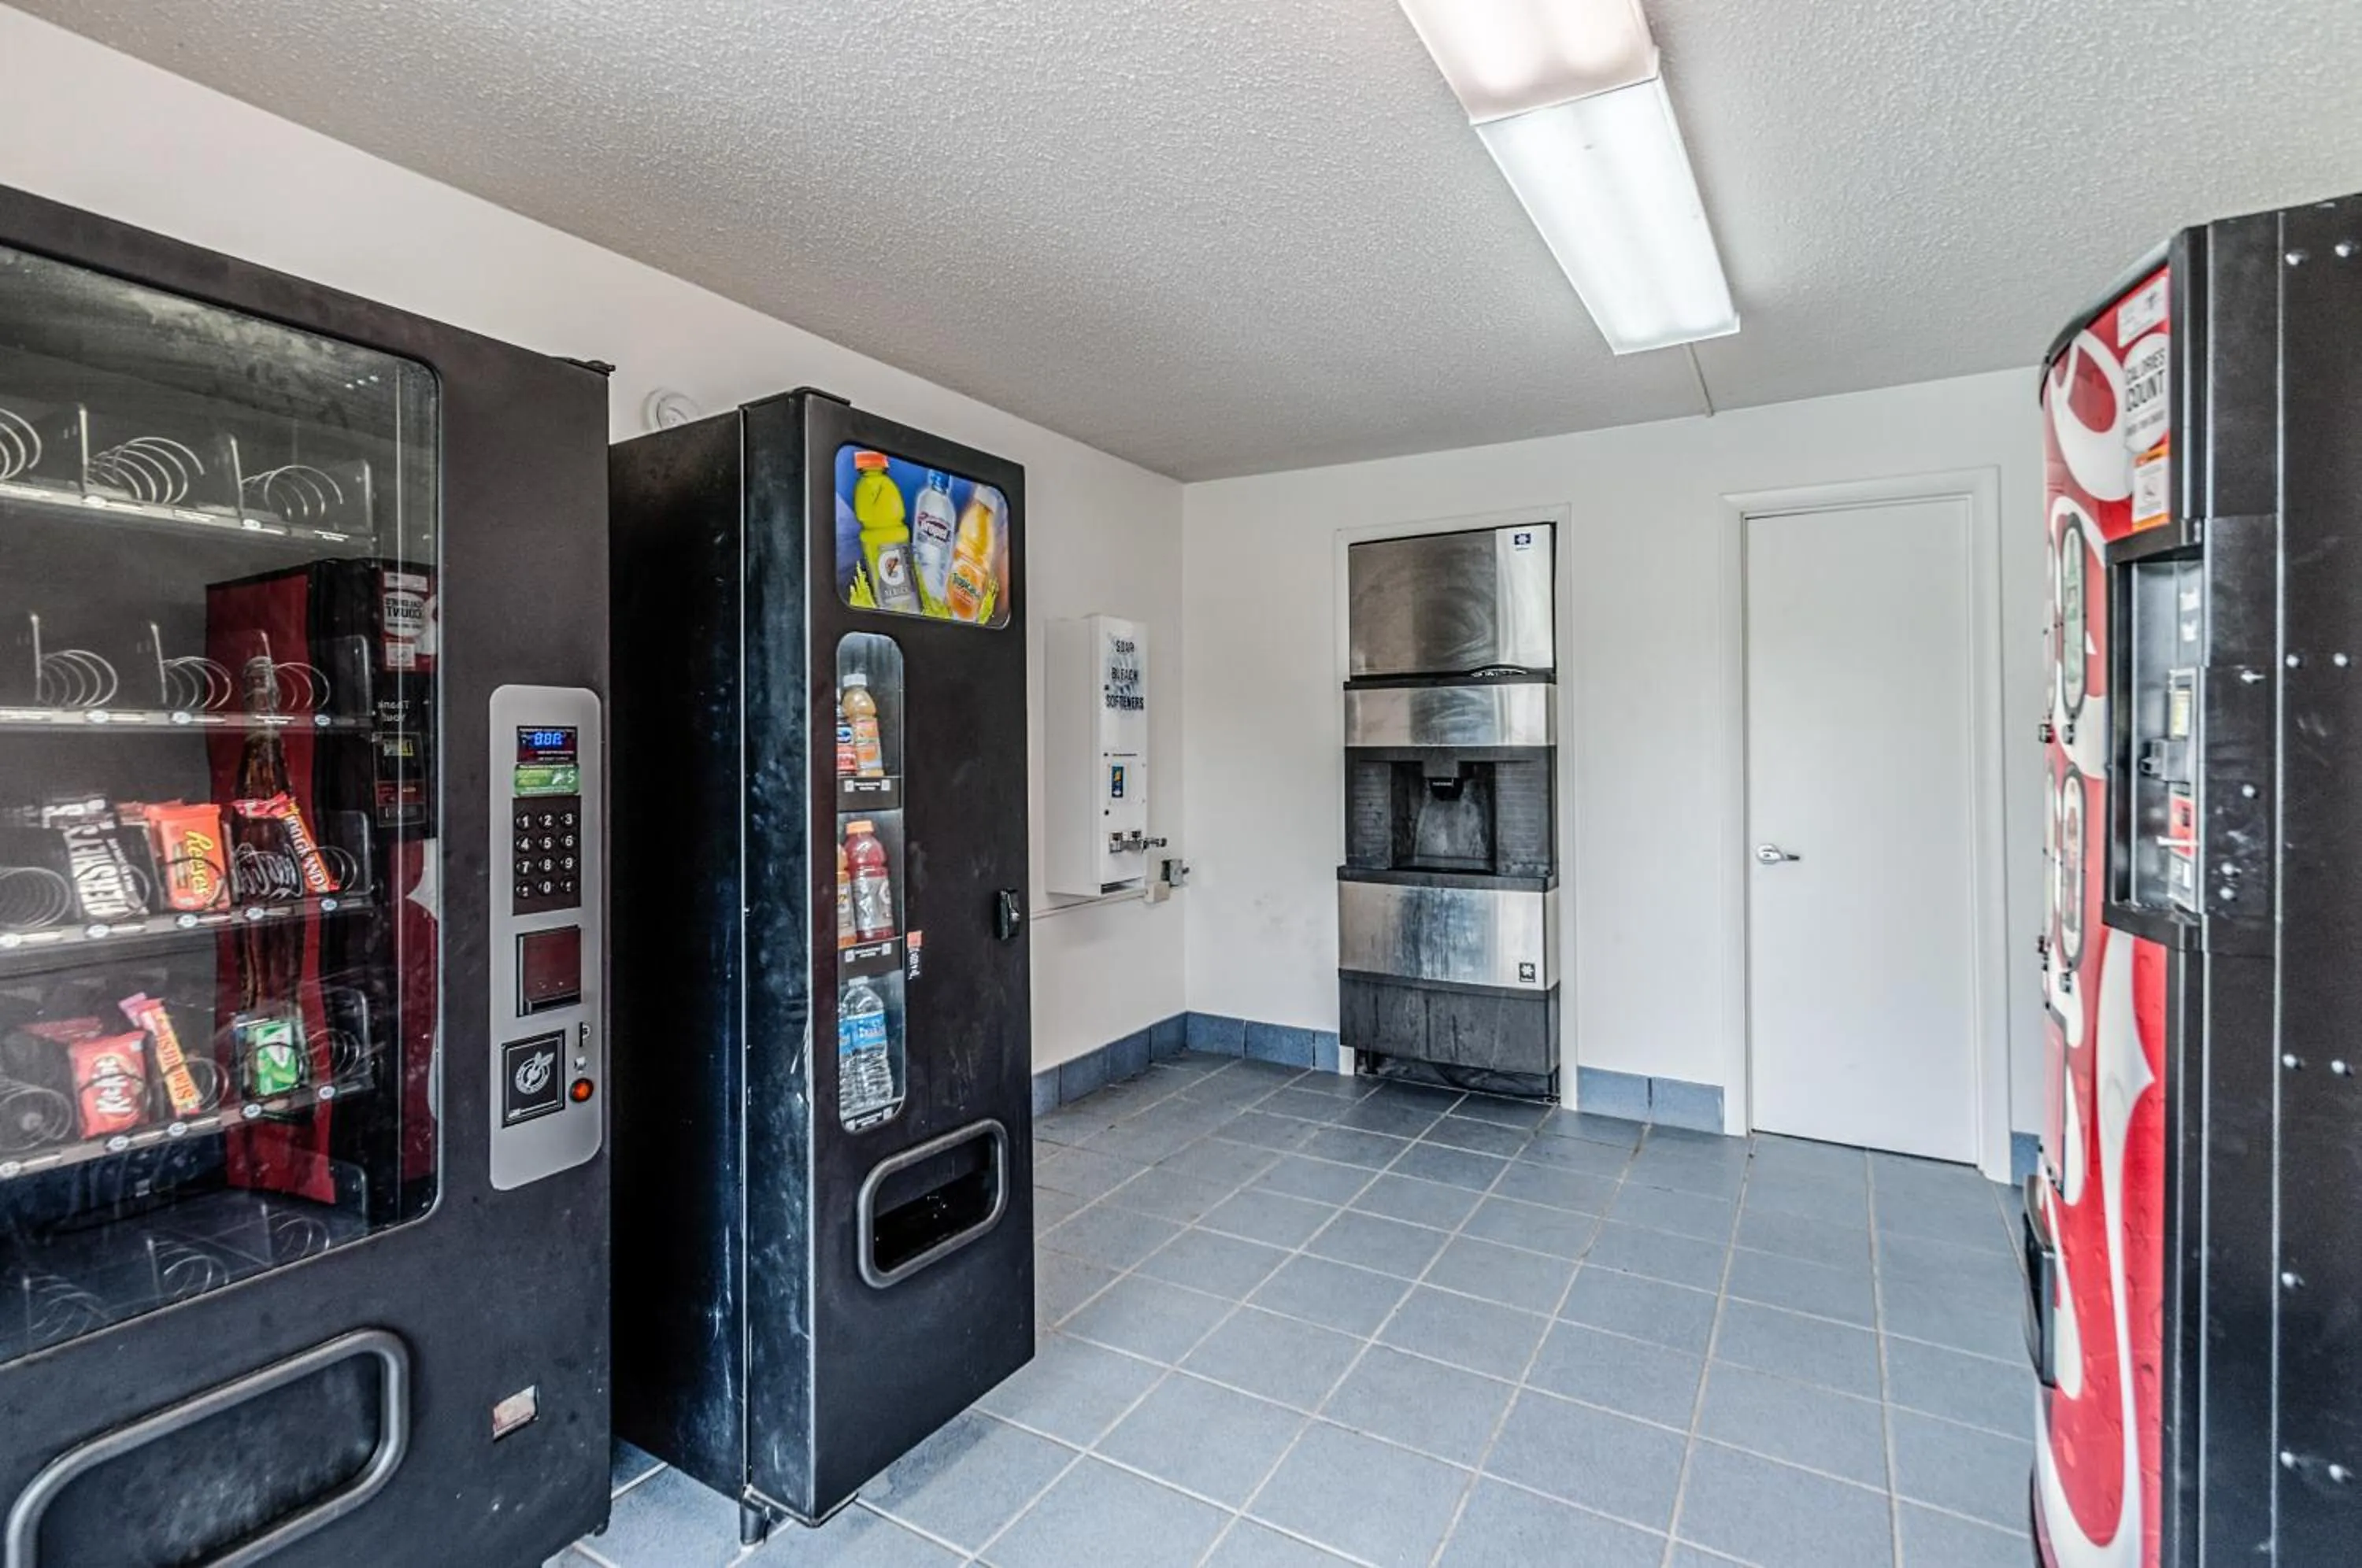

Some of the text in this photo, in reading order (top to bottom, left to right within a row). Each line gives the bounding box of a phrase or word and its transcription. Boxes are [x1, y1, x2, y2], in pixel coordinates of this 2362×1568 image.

[1111, 667, 1138, 682] BLEACH
[522, 813, 573, 828] 1 2 3
[520, 835, 573, 850] 4 5 6
[522, 857, 573, 874] 7 8 9
[543, 881, 551, 893] 0
